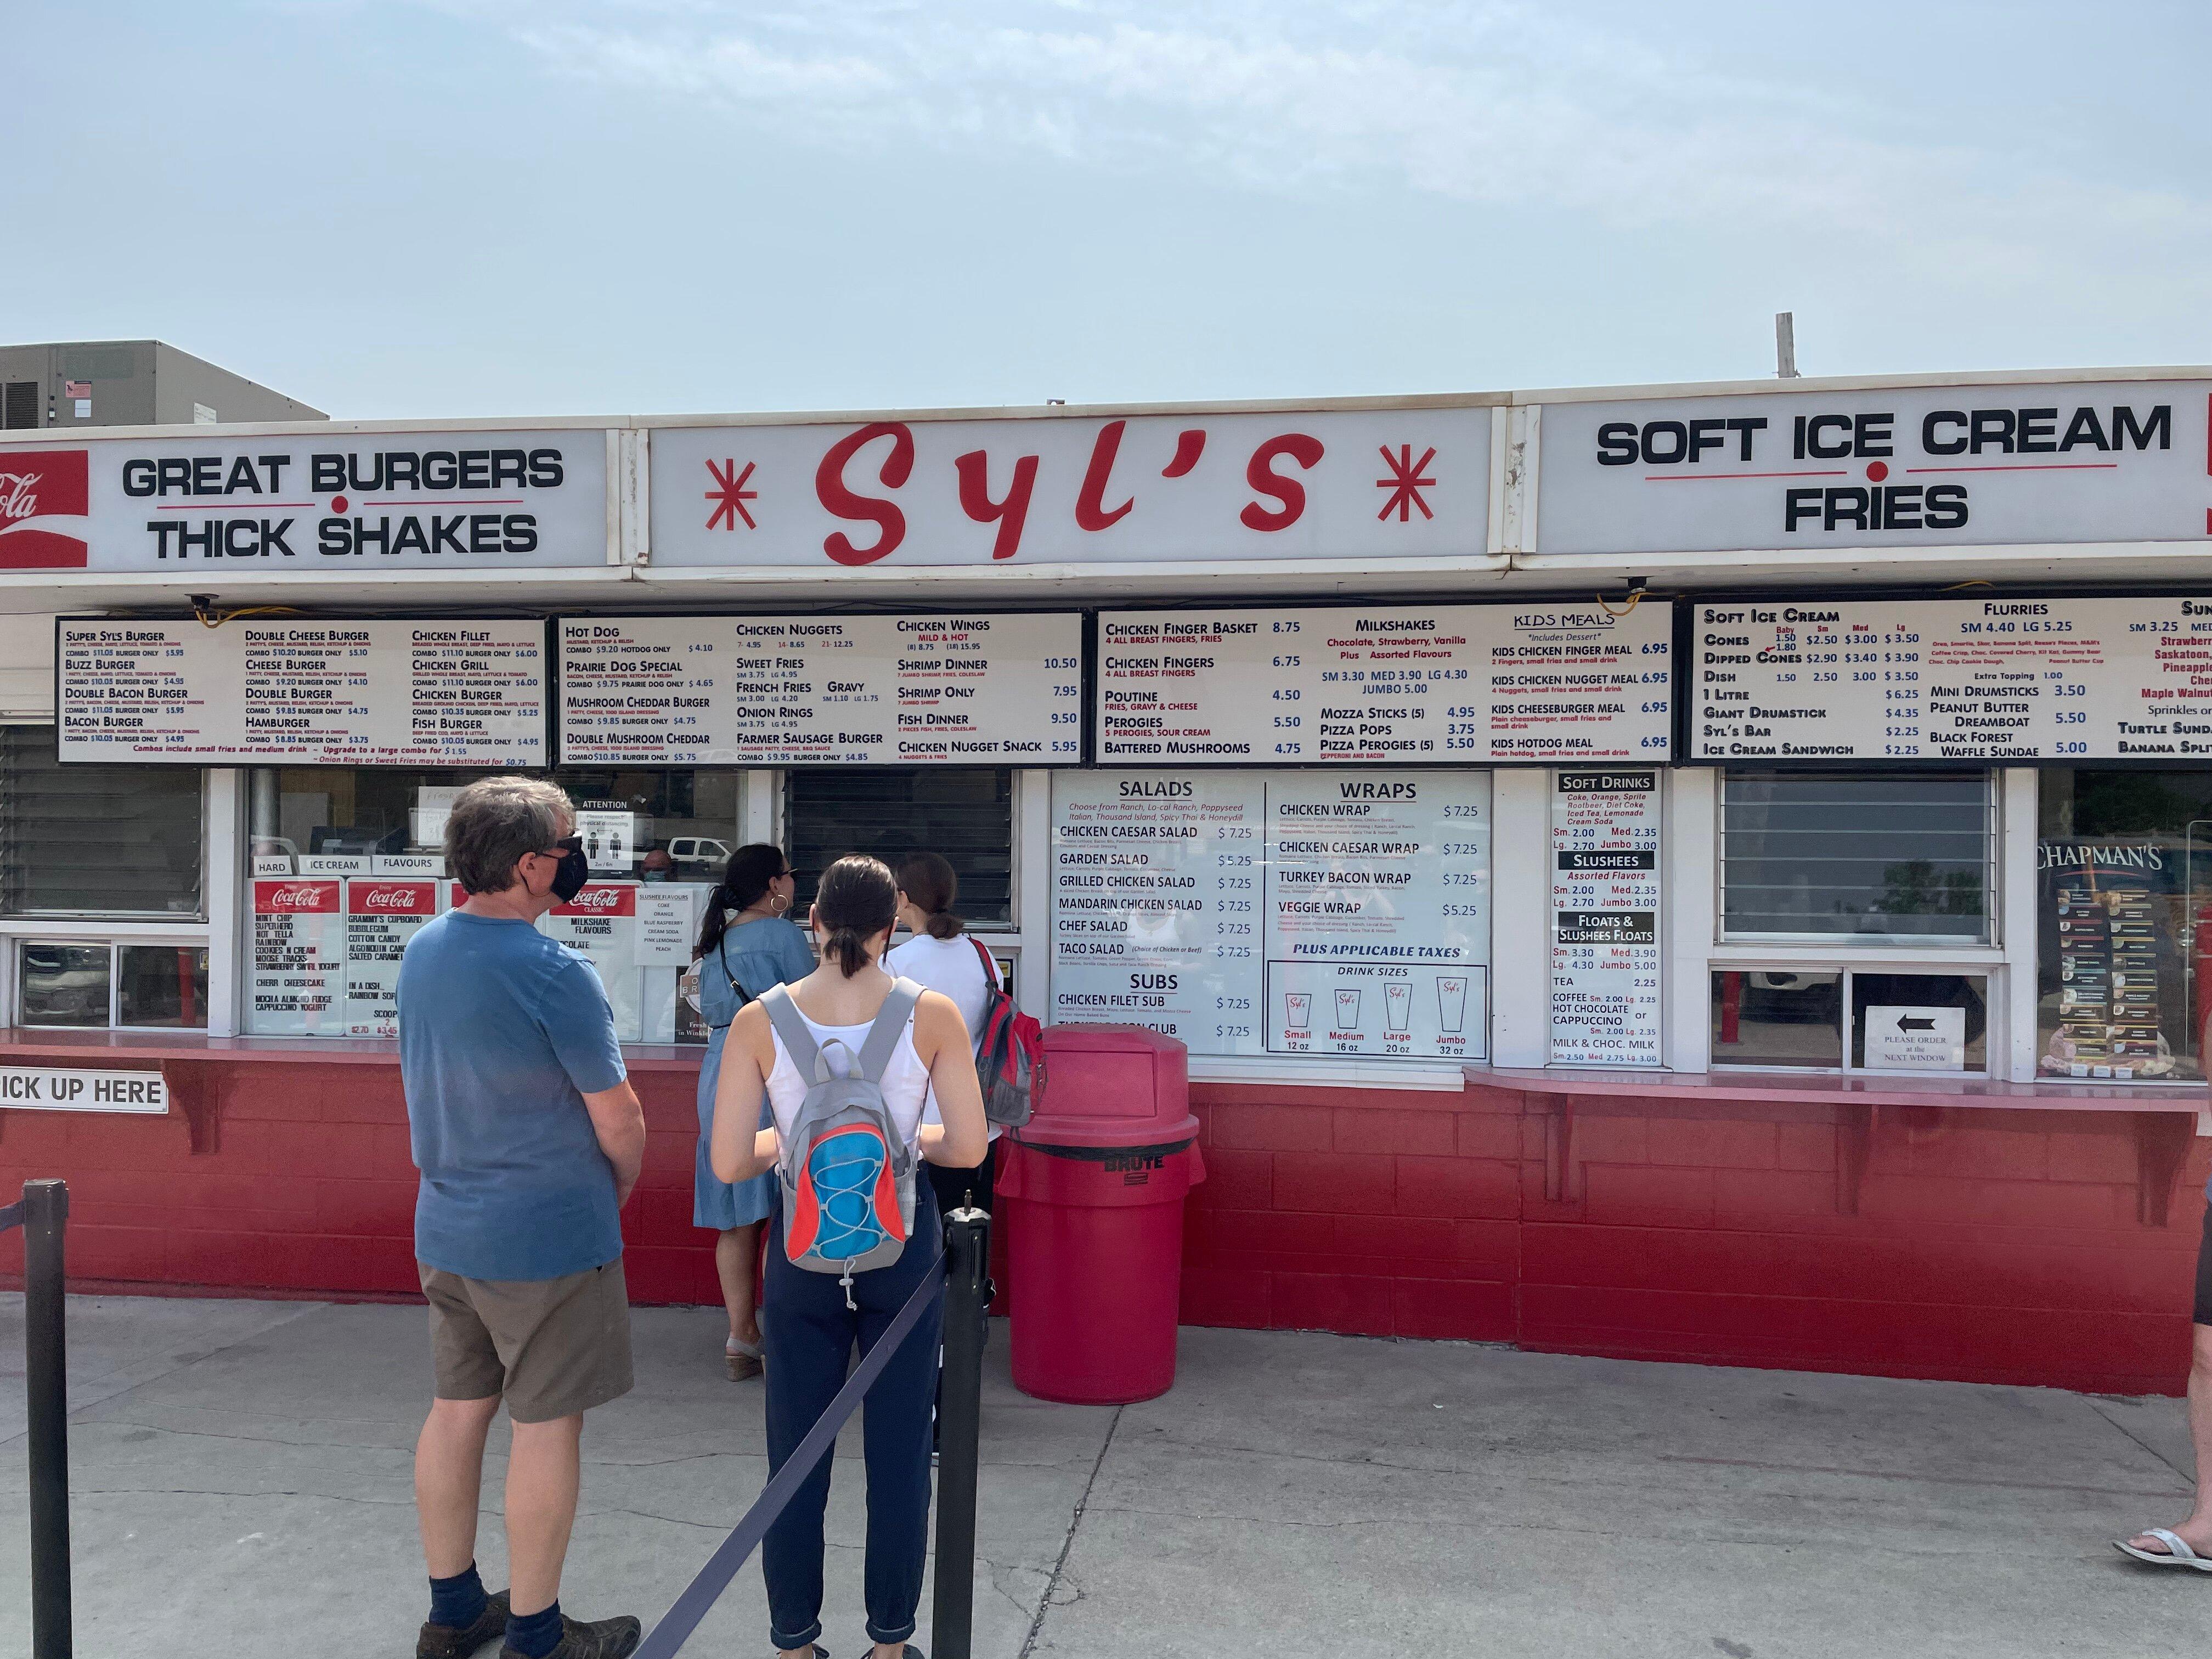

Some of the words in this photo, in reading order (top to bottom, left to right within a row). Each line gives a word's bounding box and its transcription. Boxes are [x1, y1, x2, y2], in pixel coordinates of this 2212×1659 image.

[1598, 417, 1767, 465] SOFT
[1794, 413, 1894, 459] ICE
[1922, 405, 2171, 455] CREAM
[123, 455, 290, 496] GREAT
[312, 449, 563, 493] BURGERS
[812, 420, 1324, 566] Syl's
[1786, 485, 1968, 532] FRIES
[147, 518, 295, 558] THICK
[319, 517, 537, 555] SHAKES
[1985, 603, 2048, 615] FLURRIES
[1515, 615, 1555, 627] KIDS
[1562, 613, 1616, 627] MEALS
[1704, 610, 1745, 624] SOFT
[1751, 609, 1776, 623] ICE
[1784, 608, 1839, 623] CREAM
[897, 620, 945, 631] CHICKEN
[951, 620, 990, 630] WINGS
[1106, 624, 1158, 635] CHICKEN
[1165, 623, 1207, 634] FINGER
[1214, 622, 1257, 636] BASKET
[1273, 622, 1300, 632] 8.75
[1356, 620, 1435, 631] MILKSHAKES
[1961, 623, 1981, 633] SM
[1987, 623, 2015, 632] 4.40
[2024, 622, 2039, 631] LG
[2044, 622, 2072, 631] 5.25
[66, 631, 95, 641] SUPER
[100, 631, 122, 641] SYL'S
[126, 631, 164, 641] BURGER
[413, 630, 456, 640] CHICKEN
[461, 631, 490, 641] FILLET
[566, 627, 589, 637] HOT
[594, 627, 619, 637] DOG
[1328, 639, 1375, 647] Chocolate,
[1379, 637, 1430, 646] Strawberry,
[567, 662, 606, 672] PRAIRIE
[611, 661, 636, 672] DOG
[640, 661, 682, 672] SPECIAL
[737, 658, 771, 668] SWEET
[777, 658, 804, 668] FRIES
[898, 659, 941, 670] SHRIMP
[946, 659, 987, 669] DINNER
[1045, 658, 1076, 668] 10.50
[1704, 671, 1735, 682] DISH
[828, 681, 864, 692] GRAVY
[1363, 685, 1401, 694] JUMBO
[1405, 684, 1427, 693] 5.00
[66, 688, 104, 698] DOUBLE
[109, 688, 143, 698] BACON
[148, 688, 188, 698] BURGER
[246, 689, 286, 698] DOUBLE
[291, 689, 332, 698] BURGER
[1105, 691, 1158, 702] POUTINE
[1273, 690, 1300, 700] 4.50
[737, 707, 775, 718] ONION
[780, 707, 812, 717] RINGS
[1703, 707, 1745, 719] GIANT
[1750, 707, 1826, 718] DRUMSTICK
[1931, 702, 1978, 713] PEANUT
[1984, 702, 2028, 712] BUTTER
[65, 716, 99, 726] BACON
[104, 716, 143, 726] BURGER
[246, 717, 309, 727] HAMBURGER
[898, 714, 922, 724] FISH
[927, 714, 968, 724] DINNER
[1052, 713, 1076, 723] 9.50
[1955, 716, 2029, 727] DREAMBOAT
[2056, 712, 2085, 723] 5.50
[1105, 742, 1161, 753] BATTERED
[1167, 742, 1250, 753] MUSHROOMS
[1275, 743, 1300, 753] 4.75
[1492, 740, 1514, 748] KIDS
[1518, 739, 1562, 748] HOTDOG
[1566, 738, 1593, 747] MEAL
[1641, 737, 1667, 747] 6.95
[1564, 777, 1597, 789] SOFT
[1602, 777, 1650, 788] DRINKS
[1120, 781, 1192, 797] SALADS
[1340, 782, 1416, 798] WRAPS
[1060, 854, 1107, 864] GARDEN
[1111, 854, 1148, 865] SALAD
[1574, 855, 1638, 866] SLUSHEES
[1279, 872, 1324, 882] TURKEY
[1329, 872, 1369, 883] BACON
[1374, 873, 1410, 884] WRAP
[272, 888, 321, 906] Coca-Cola
[366, 889, 416, 907] Coca-Cola
[1059, 921, 1086, 930] CHEF
[1090, 921, 1127, 931] SALAD
[1579, 915, 1620, 927] FLOATS
[1623, 916, 1633, 927] &
[1059, 943, 1086, 953] TACO
[1090, 944, 1124, 954] SALAD
[1293, 944, 1327, 954] PLUS
[1330, 945, 1414, 956] APPLICABLE
[1419, 947, 1460, 957] TAXES
[1338, 967, 1374, 975] DRINK
[1130, 974, 1177, 989] SUBS
[1575, 1005, 1628, 1013] CHOCOLATE
[1554, 1016, 1622, 1025] CAPPUCCINO
[1285, 1030, 1311, 1039] Small
[1384, 1032, 1410, 1041] Large
[1436, 1035, 1465, 1044] Jumbo
[1386, 1045, 1397, 1053] 20
[0, 1076, 41, 1099] ICK
[52, 1078, 83, 1100] UP
[95, 1080, 160, 1103] HERE
[1104, 1155, 1165, 1172] BRUTE
